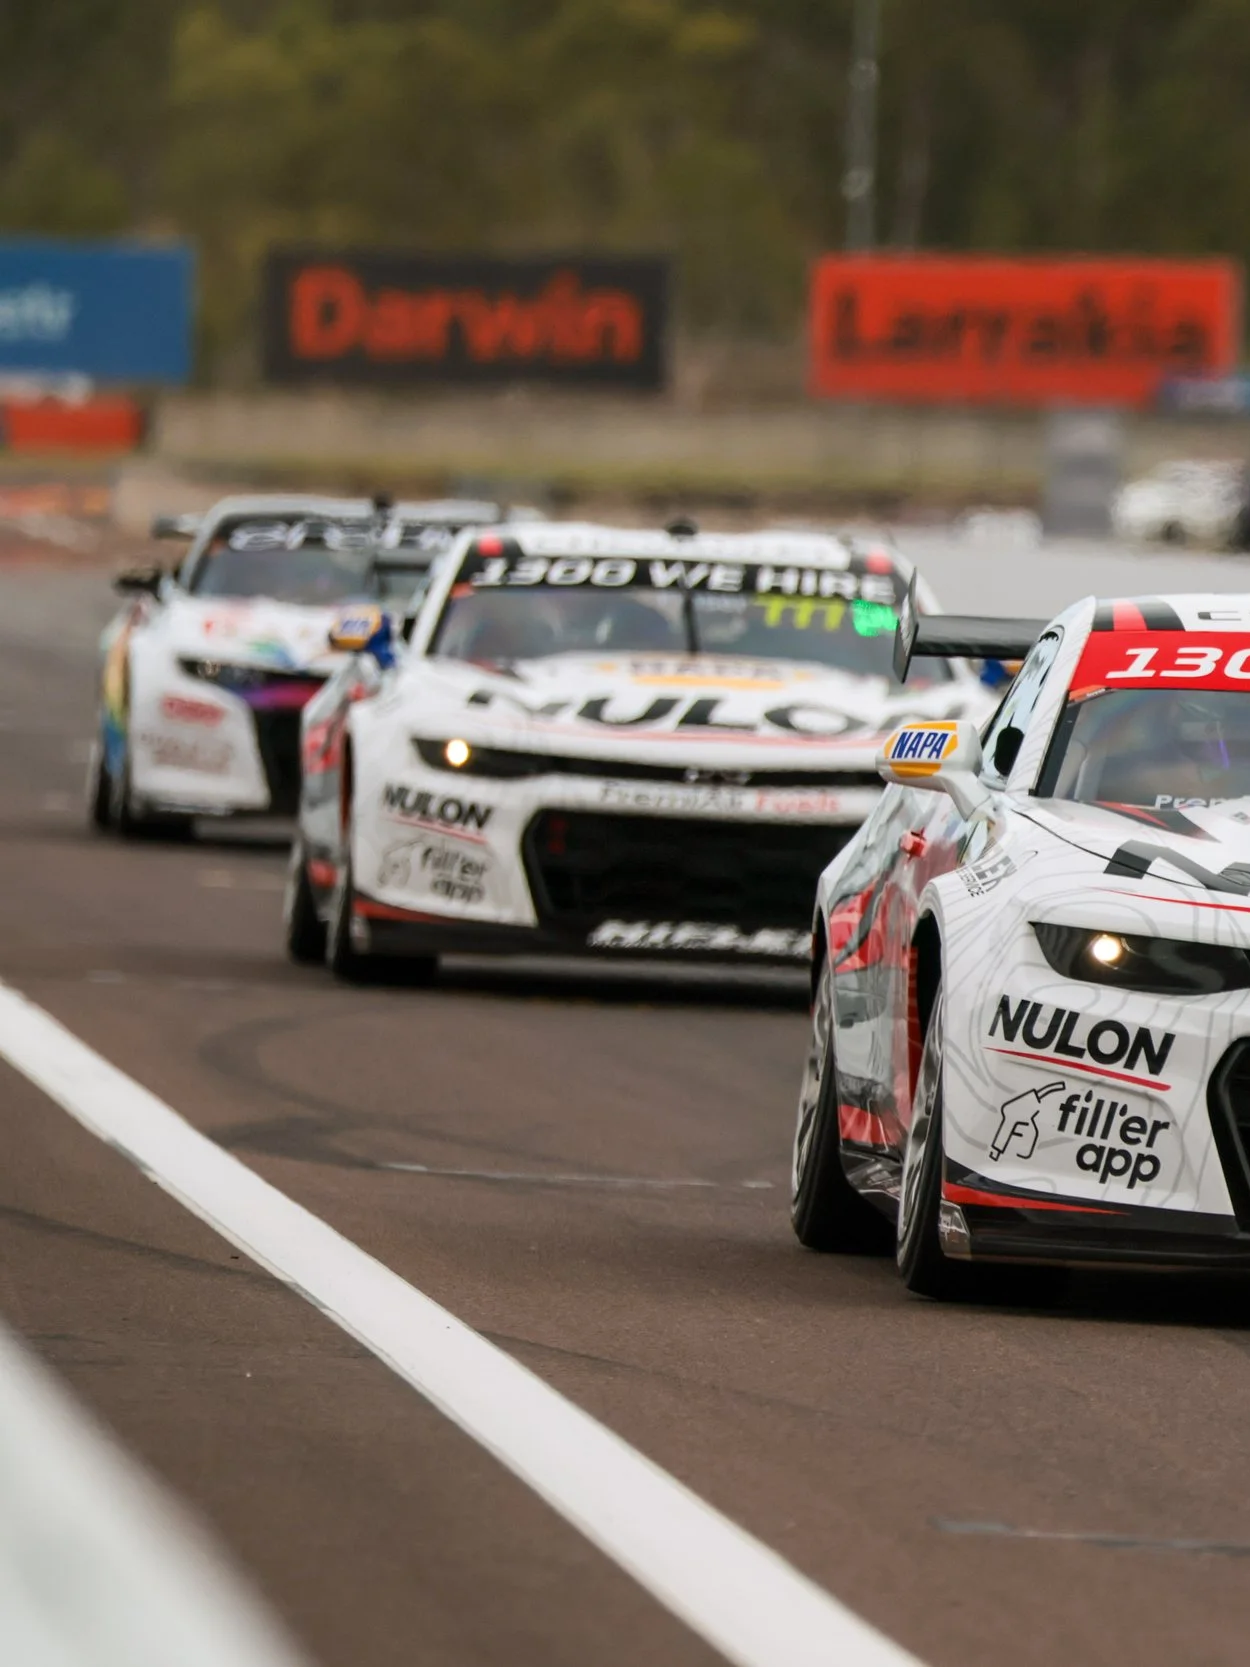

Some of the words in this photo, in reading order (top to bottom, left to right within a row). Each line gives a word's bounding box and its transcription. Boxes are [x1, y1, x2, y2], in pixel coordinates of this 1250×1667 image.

[290, 264, 642, 363] Darwin
[473, 557, 637, 586] 1300
[649, 560, 745, 592] WE
[755, 566, 896, 602] HIRE
[891, 731, 949, 759] NAPA
[383, 783, 493, 828] NULON
[988, 995, 1176, 1076] NULON
[1075, 1139, 1162, 1189] app
